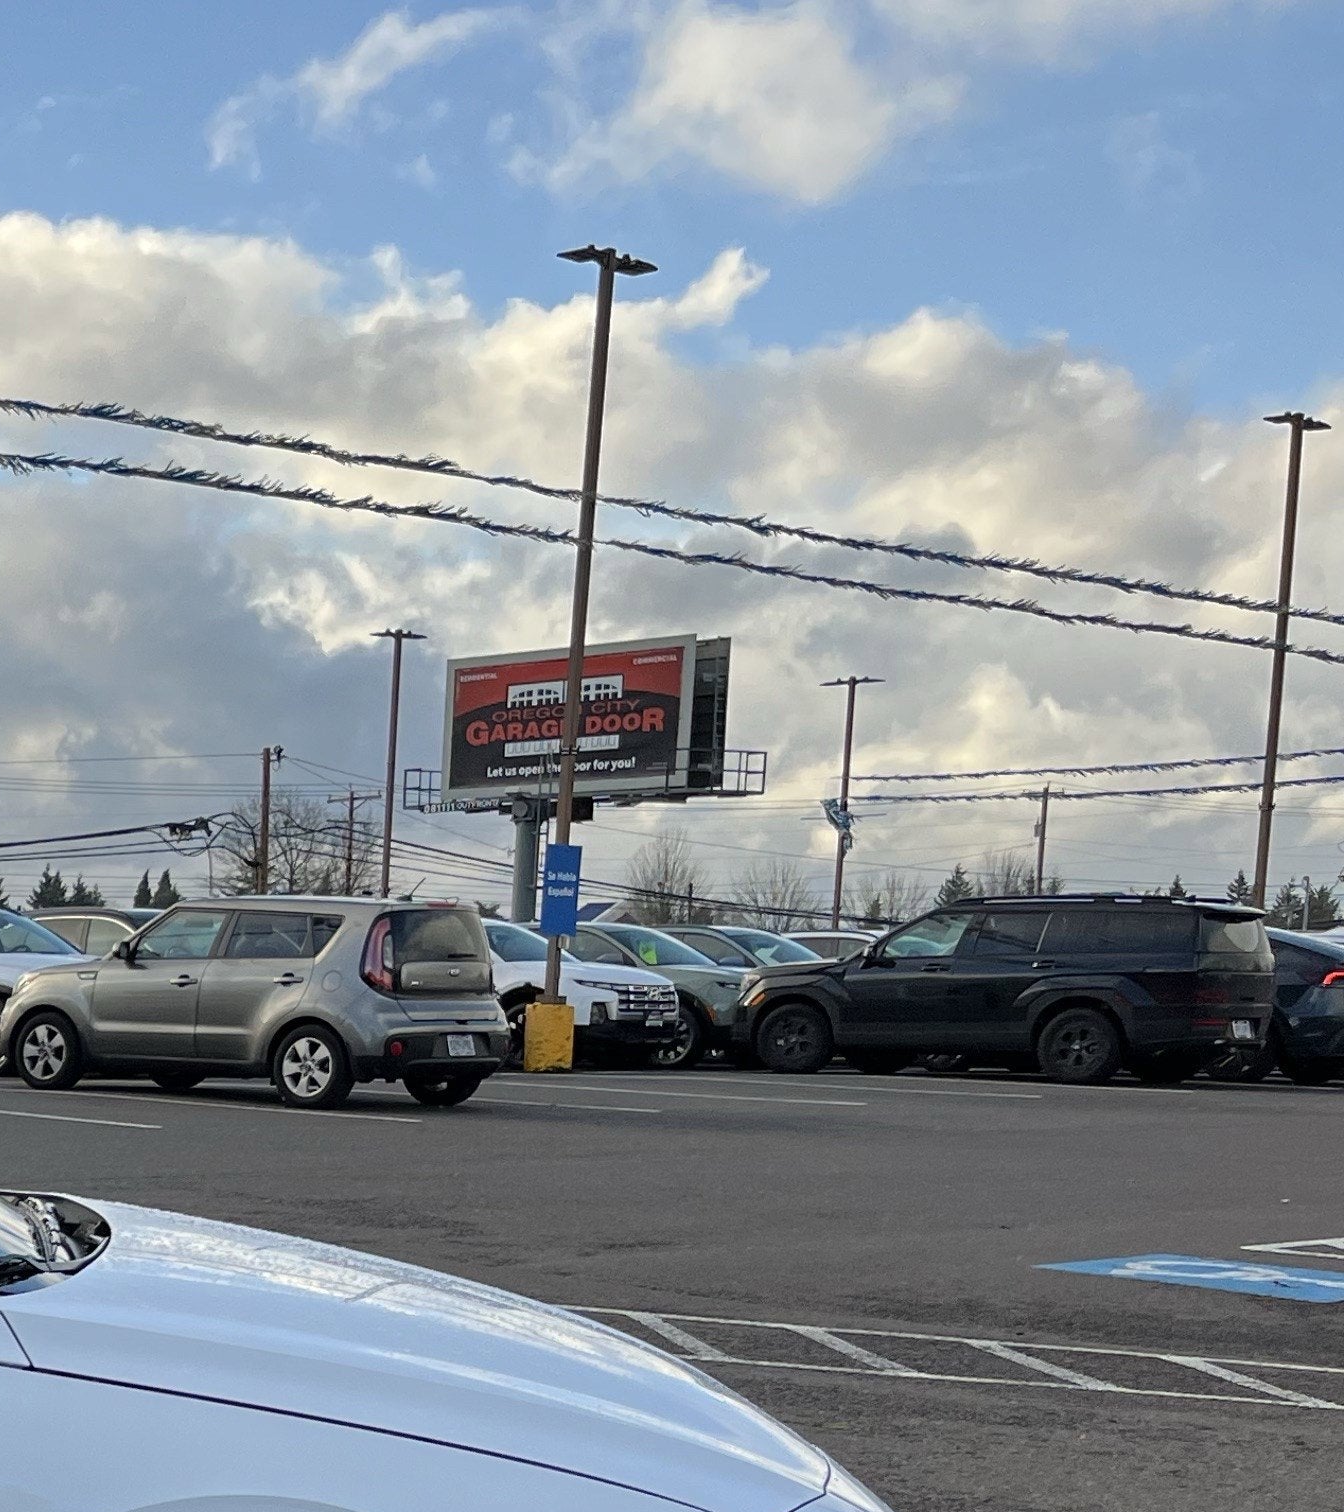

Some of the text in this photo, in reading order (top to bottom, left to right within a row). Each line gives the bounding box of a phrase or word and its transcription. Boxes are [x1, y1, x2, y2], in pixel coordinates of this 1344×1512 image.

[632, 654, 677, 665] COMMERCIAL
[492, 699, 640, 723] OREGO CITY
[585, 706, 665, 734] DOOR
[487, 766, 503, 778] Let
[505, 767, 517, 777] us
[519, 766, 544, 778] open
[593, 759, 610, 770] for
[610, 756, 636, 772] you!
[547, 871, 577, 882] Se Habla
